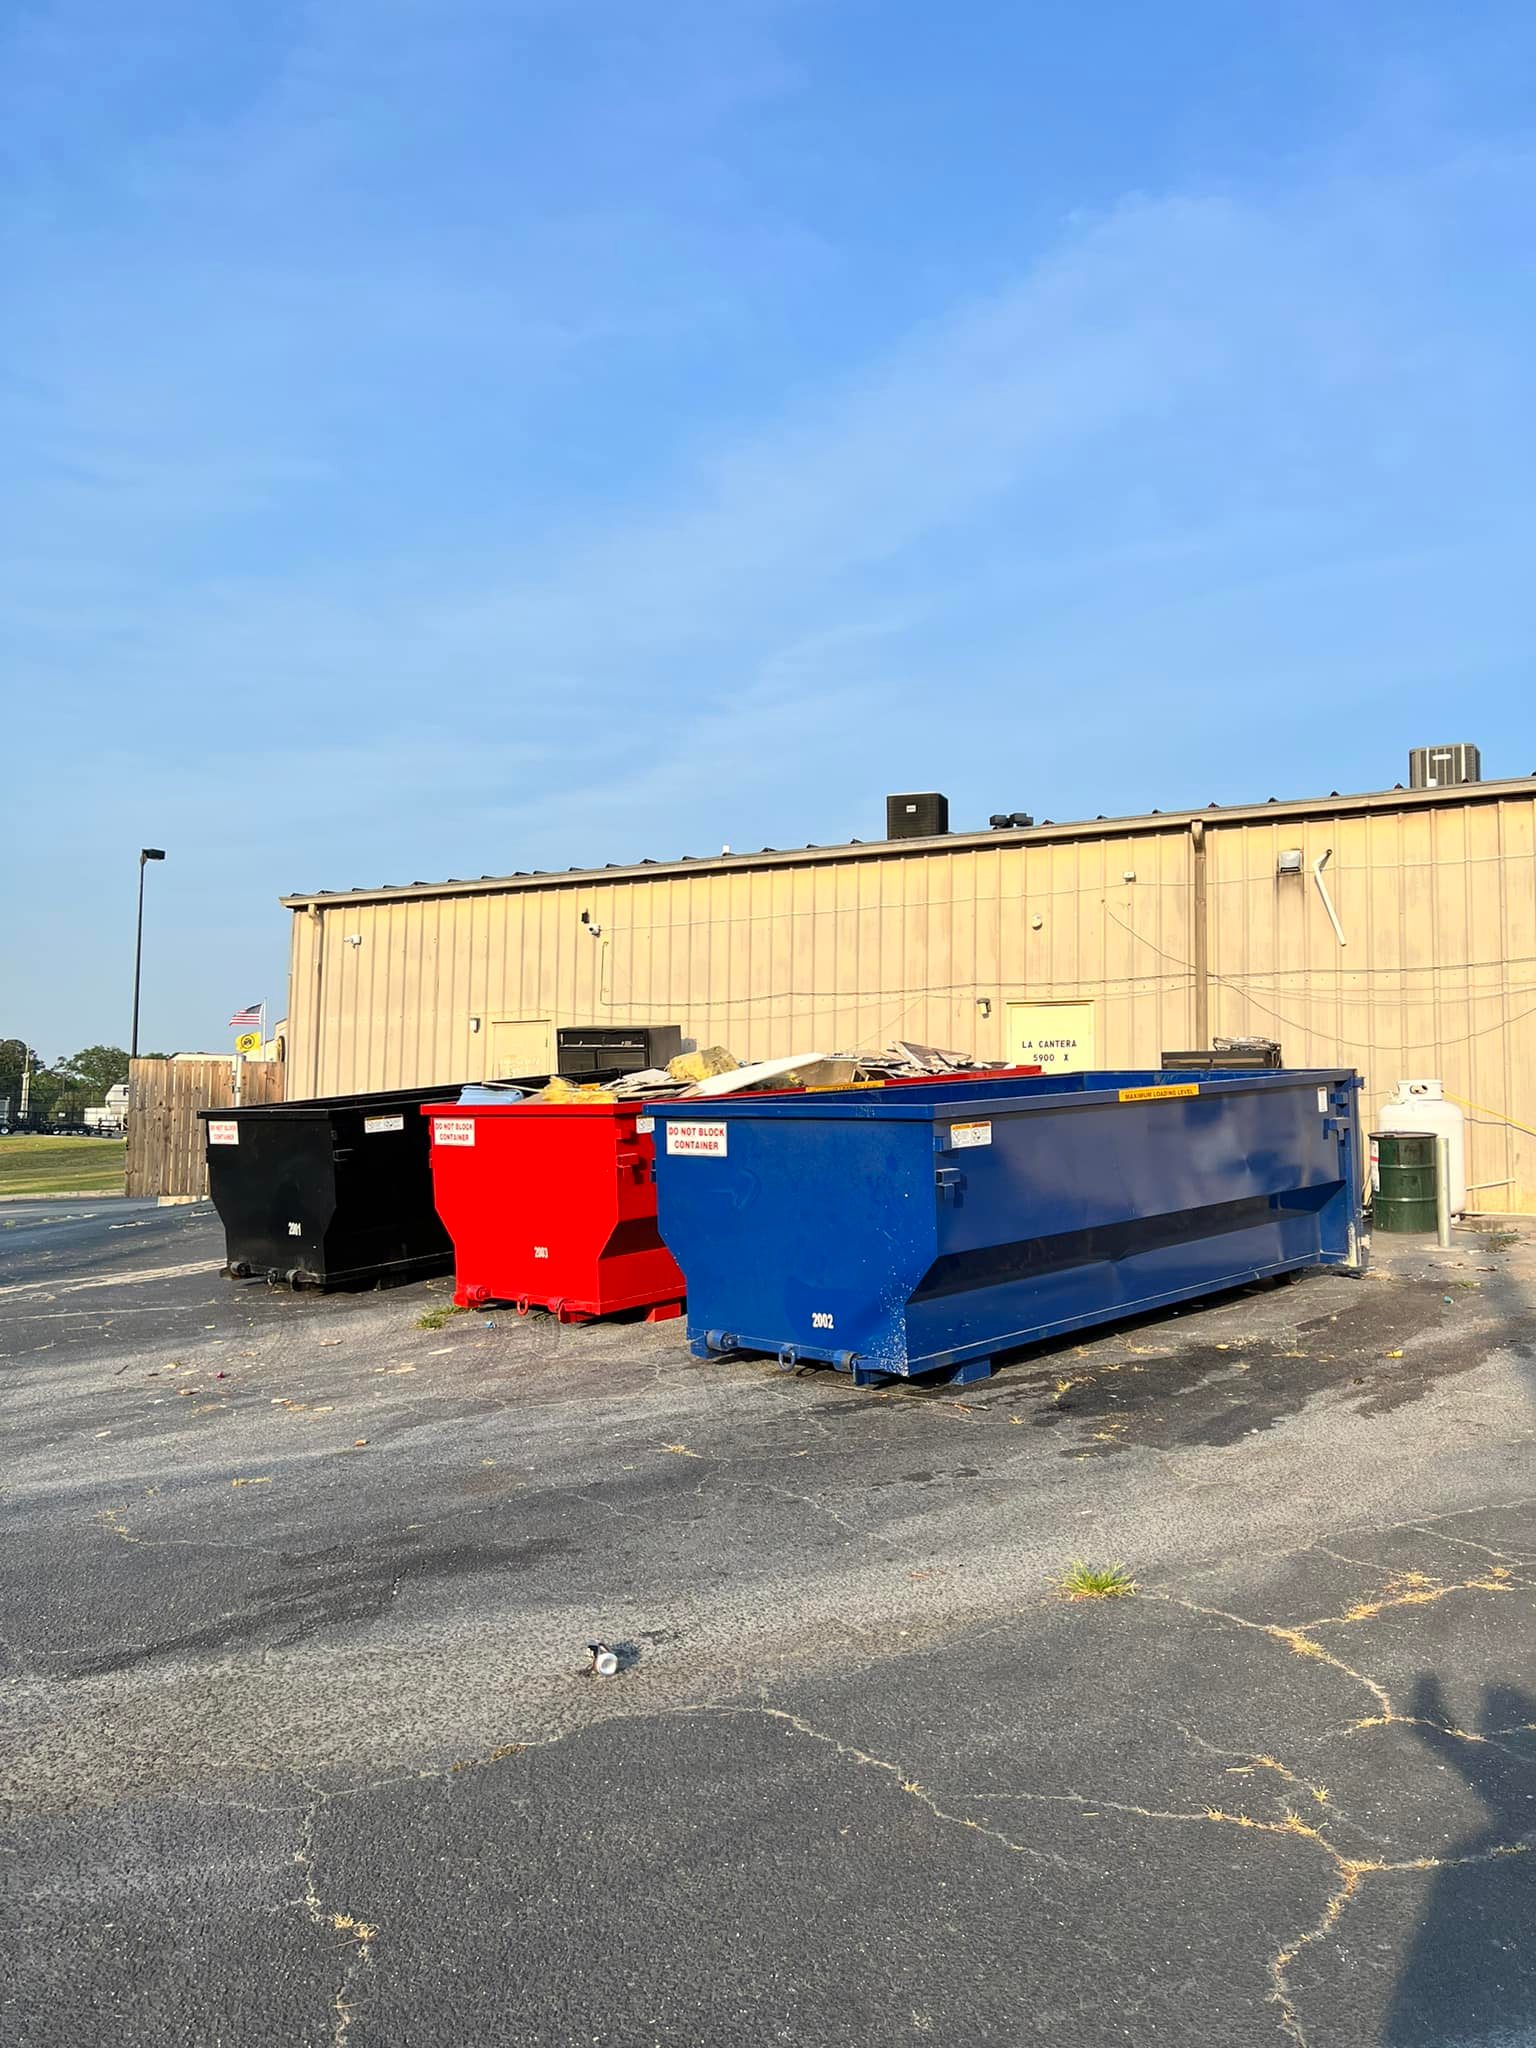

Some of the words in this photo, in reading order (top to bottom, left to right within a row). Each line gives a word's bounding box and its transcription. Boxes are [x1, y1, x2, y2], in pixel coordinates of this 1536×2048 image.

[1022, 1040, 1033, 1048] LA
[1038, 1039, 1077, 1048] CANTERA
[1033, 1054, 1055, 1062] 5900
[435, 1122, 442, 1130] DO
[443, 1122, 454, 1130] NOT
[455, 1122, 472, 1130] BLOCK
[668, 1127, 679, 1135] DO
[681, 1127, 696, 1136] NOT
[698, 1128, 725, 1136] BLOCK
[440, 1133, 469, 1141] CONTAINER
[674, 1140, 719, 1150] CONTAINER
[811, 1312, 834, 1329] 2002
